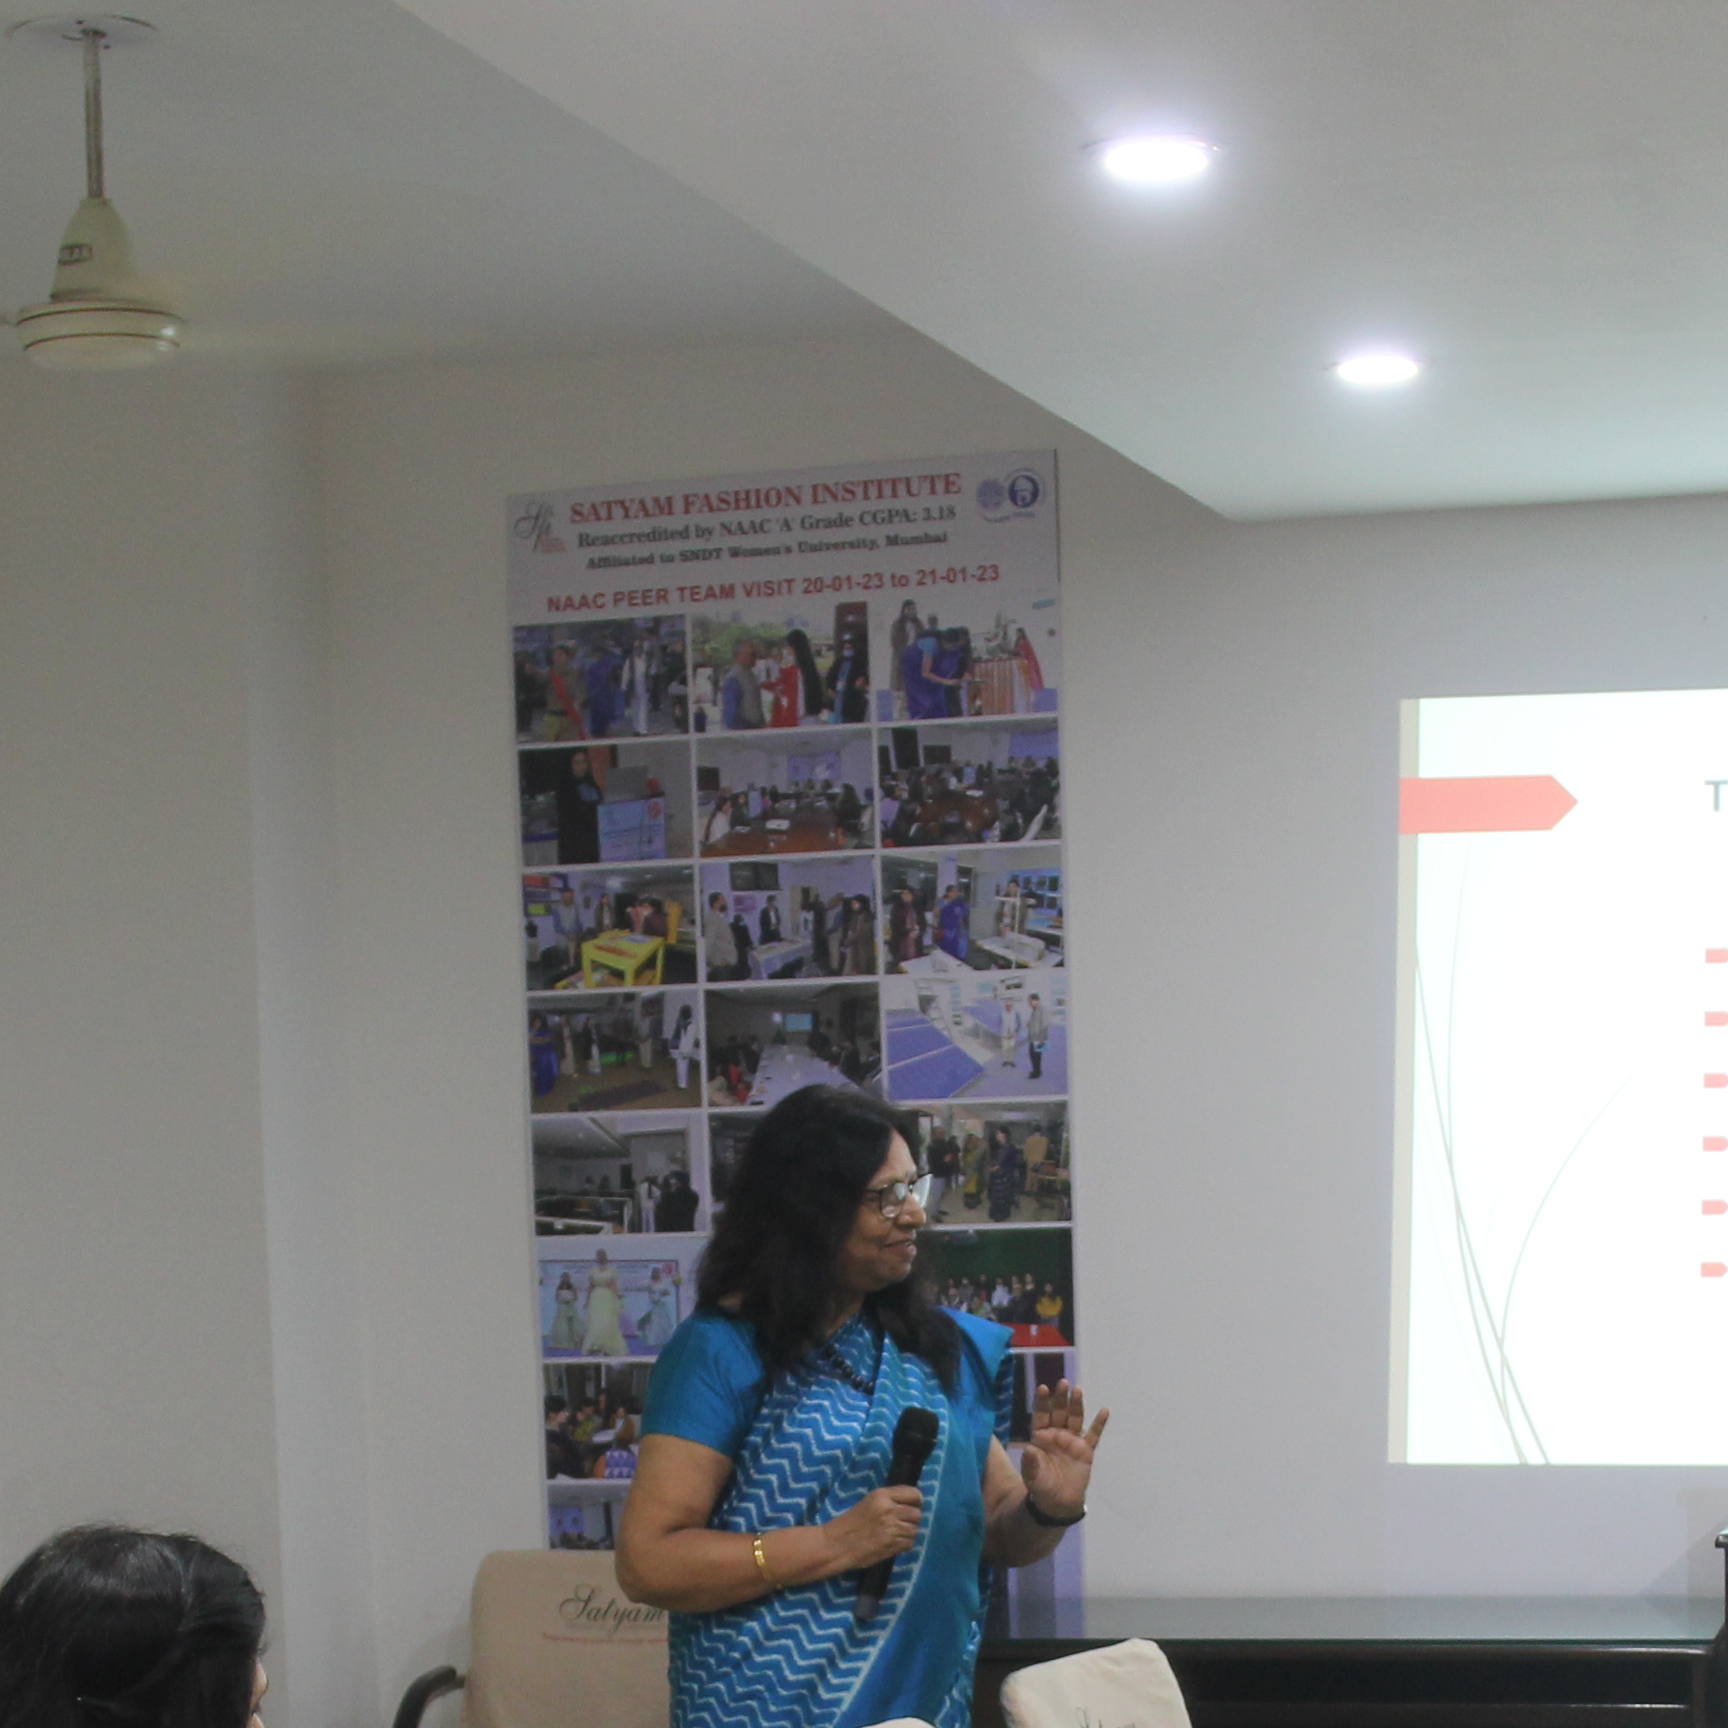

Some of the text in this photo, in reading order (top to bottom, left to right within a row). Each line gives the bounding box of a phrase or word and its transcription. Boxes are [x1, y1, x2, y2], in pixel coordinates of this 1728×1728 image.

[570, 473, 962, 524] SATYAM FASHION INSTITUTE
[578, 525, 690, 548] Reaccredited
[695, 523, 714, 541] by
[720, 517, 772, 537] NAAC
[800, 510, 854, 531] Grade
[860, 507, 918, 527] CGPA:
[923, 504, 956, 522] 3.18
[660, 551, 675, 563] to
[679, 546, 723, 563] SNDT
[885, 531, 948, 548] Mumbai
[546, 564, 1001, 613] NAAC PEER TEAM VISIT 20-01-23 to 21-01-23
[559, 1583, 663, 1638] Satyam
